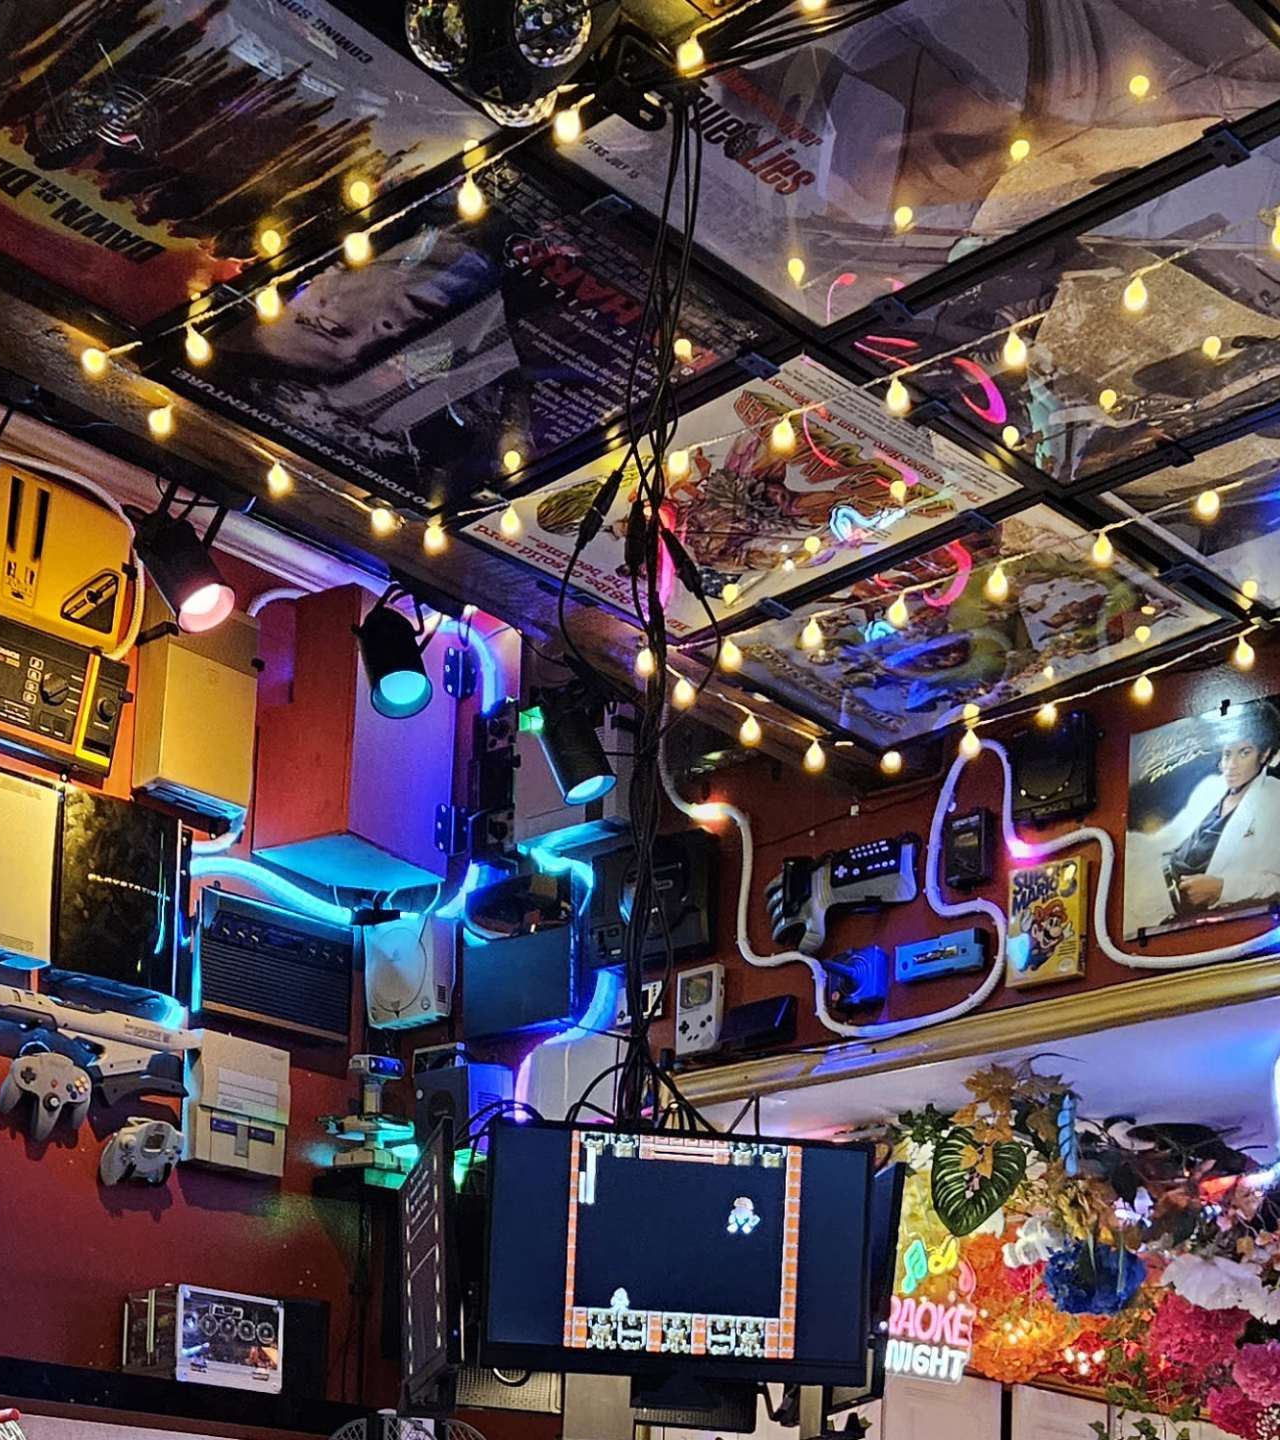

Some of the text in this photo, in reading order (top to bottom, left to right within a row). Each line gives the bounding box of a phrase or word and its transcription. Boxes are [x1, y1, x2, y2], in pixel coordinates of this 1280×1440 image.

[311, 18, 374, 64] COMING
[736, 136, 816, 195] Lies
[31, 189, 57, 204] OF
[37, 179, 70, 201] THE
[49, 198, 166, 264] DAWN
[169, 366, 286, 430] ADVENTURE!
[335, 451, 356, 468] OF
[355, 463, 416, 499] STORIES
[519, 546, 565, 575] solid
[889, 1295, 974, 1346] RAOKE
[885, 1339, 966, 1381] NIGHT
